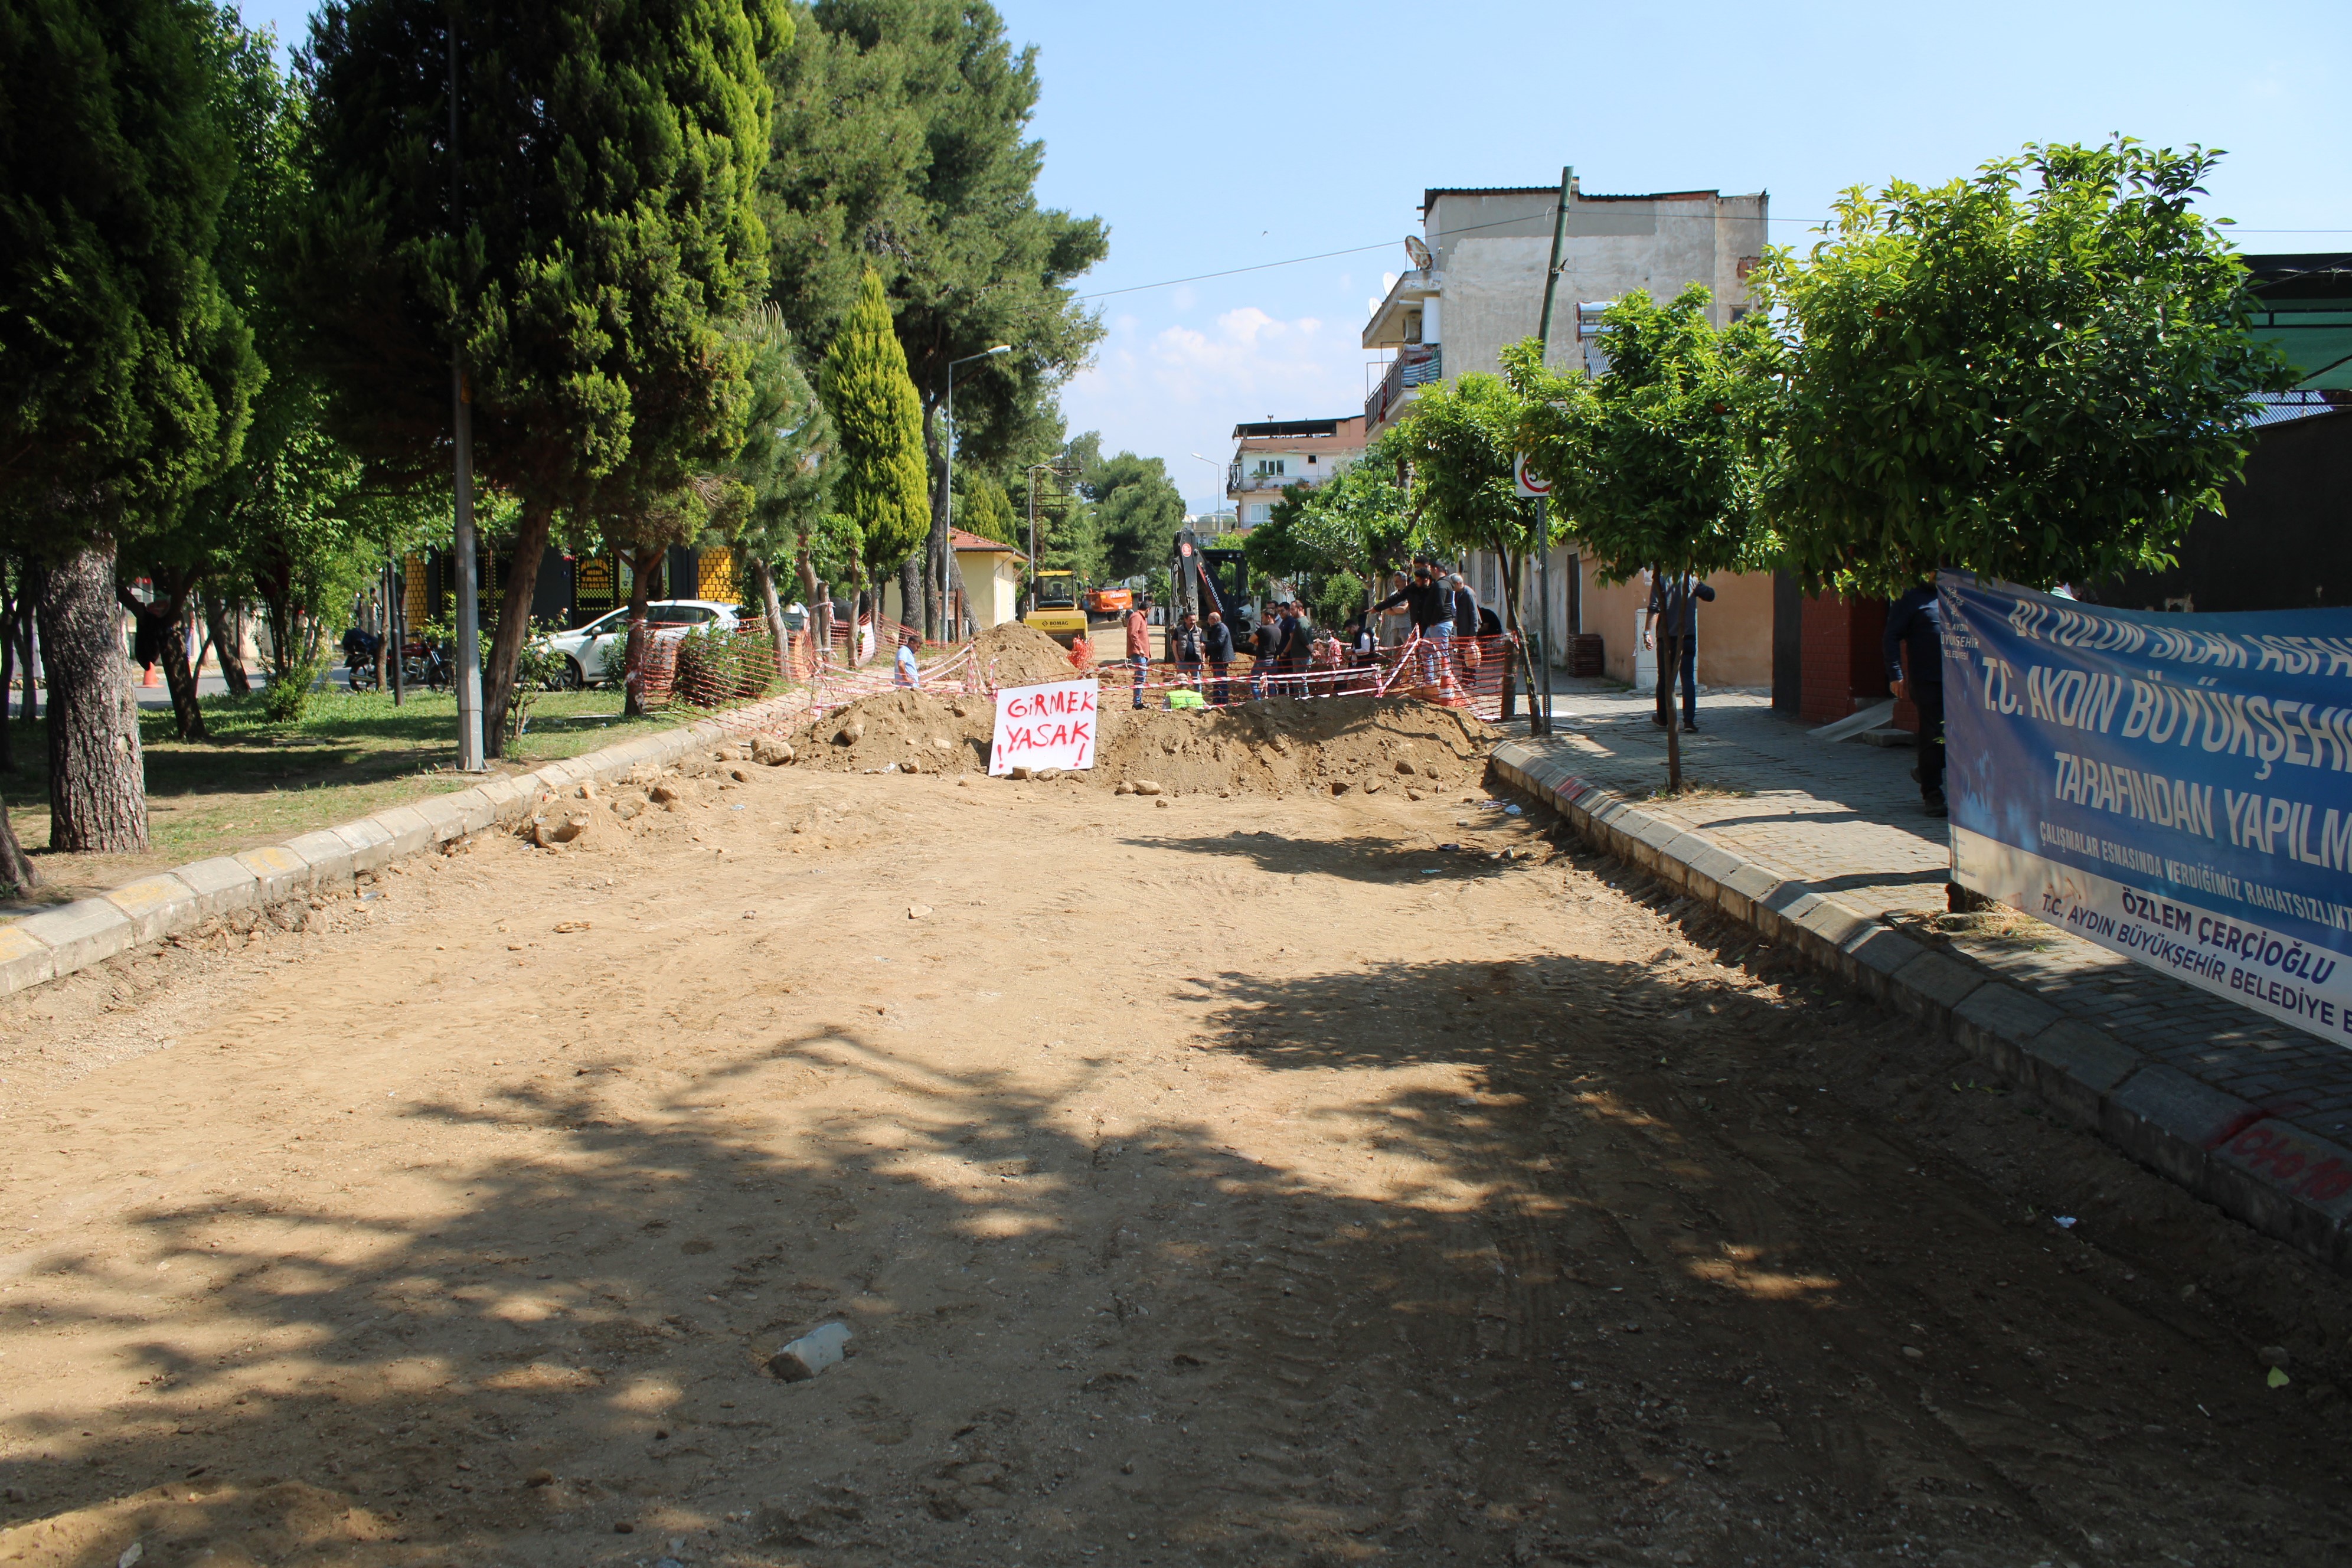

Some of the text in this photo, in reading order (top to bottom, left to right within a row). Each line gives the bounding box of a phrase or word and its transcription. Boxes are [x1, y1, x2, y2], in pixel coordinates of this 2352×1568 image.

[2008, 599, 2352, 677] BU YOLUN SICAK ASFA
[1006, 720, 1090, 753] YASAK
[1982, 657, 2352, 780] T.C. AYDIN BÜYÜKŞEHİ
[2054, 751, 2214, 839] TARAFINDAN
[2040, 821, 2100, 859] ÇALIŞMALAR
[2102, 840, 2164, 878] ESNASINDA
[2165, 858, 2243, 902] VERDİĞİMİZ
[2043, 893, 2063, 918] T.C.
[2067, 905, 2115, 937] AYDIN
[2116, 923, 2226, 984] BÜYÜKŞEHİR
[2230, 967, 2334, 1027] BELEDİYE
[2122, 886, 2336, 985] ÖZLEM ÇERÇİOĞLU
